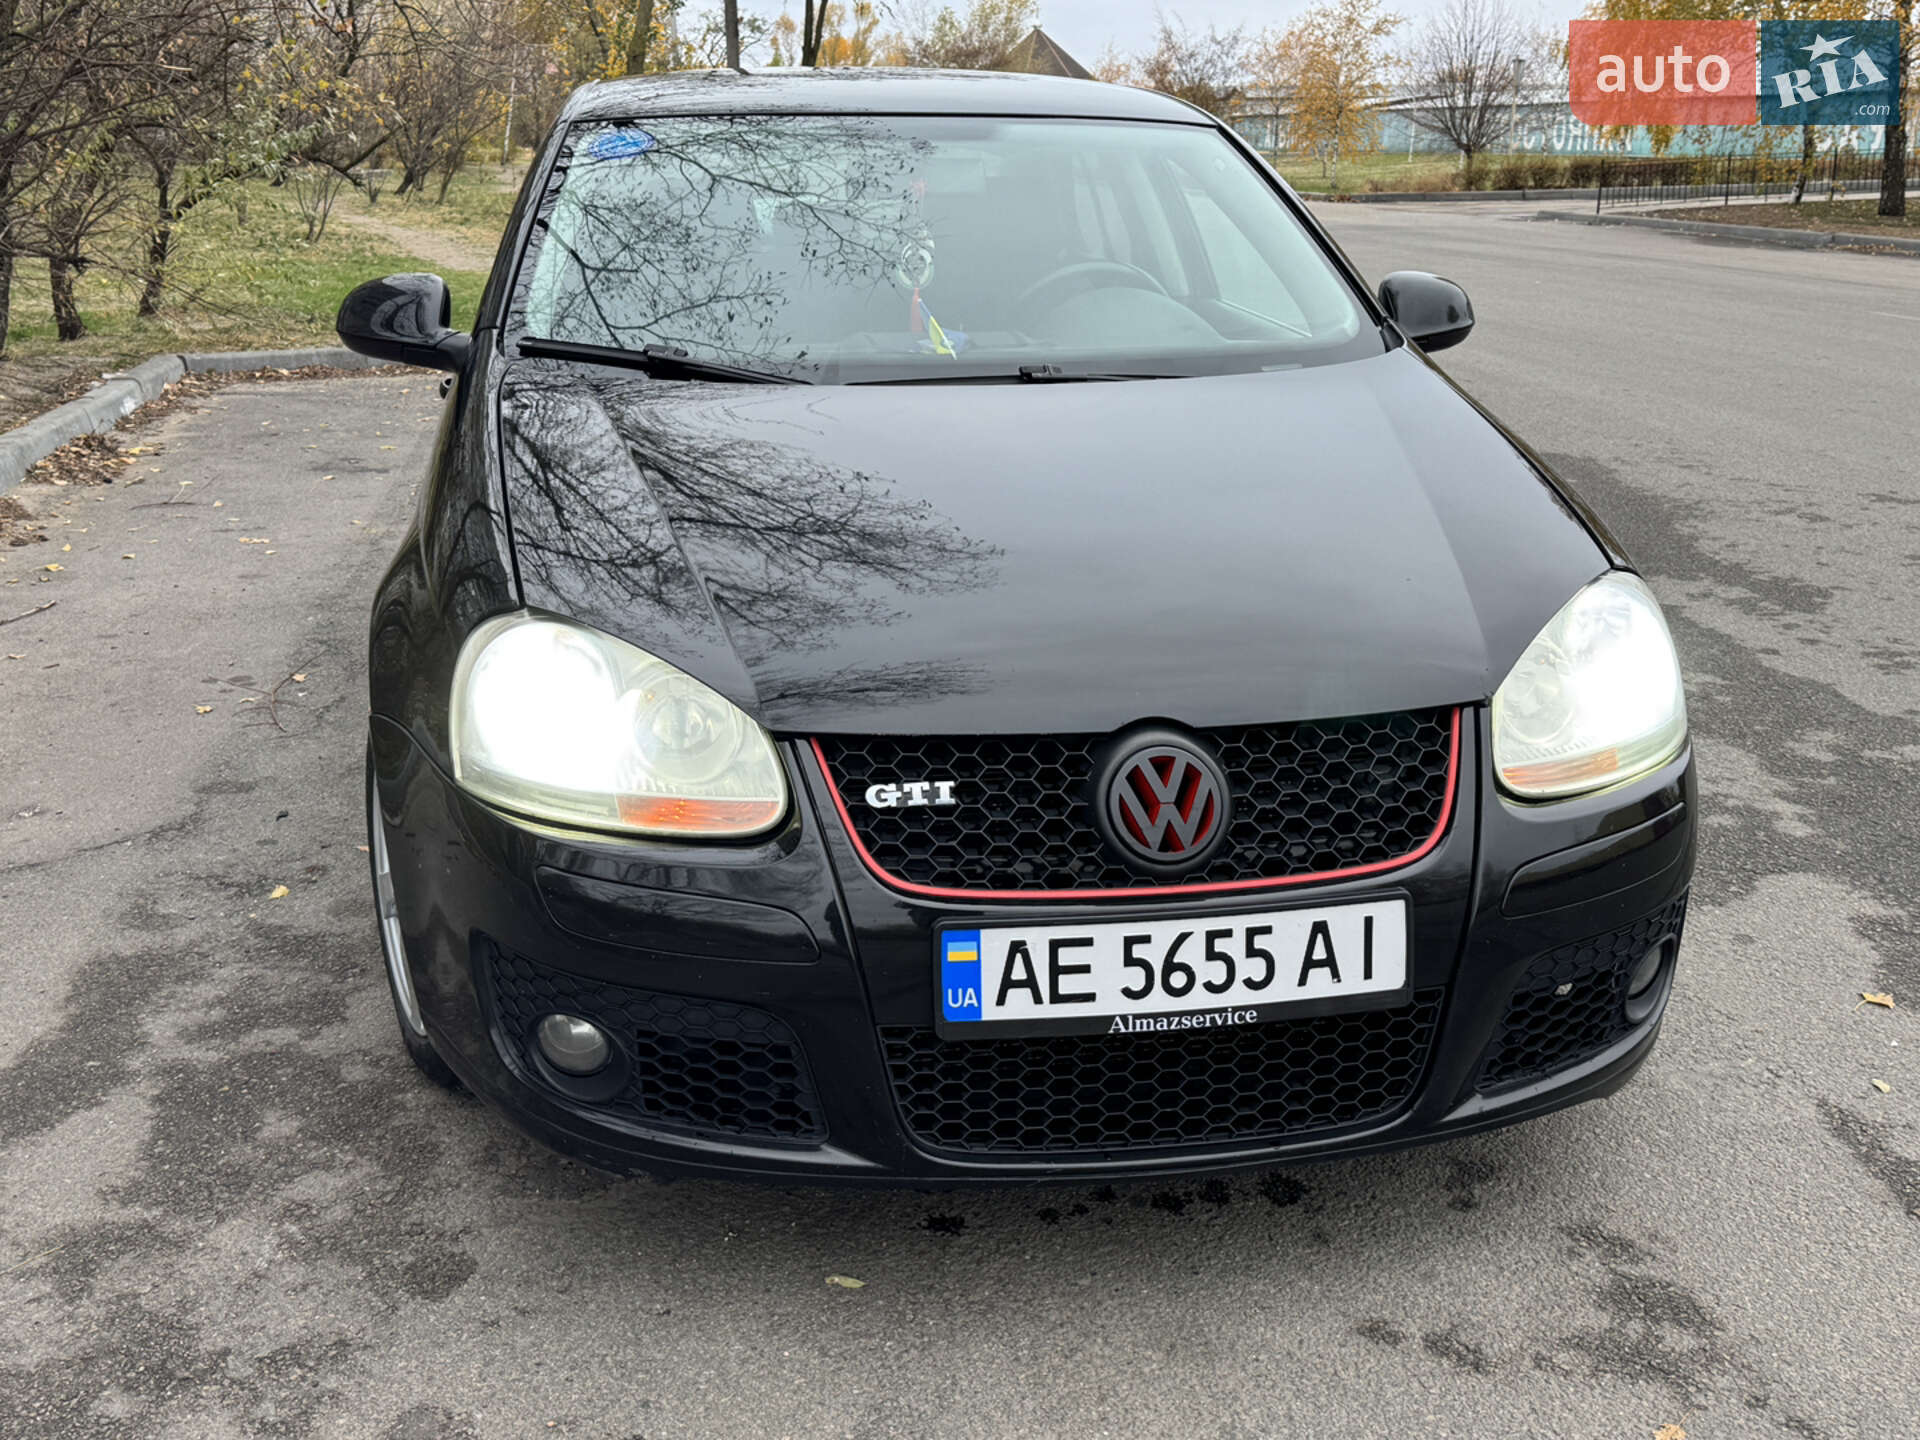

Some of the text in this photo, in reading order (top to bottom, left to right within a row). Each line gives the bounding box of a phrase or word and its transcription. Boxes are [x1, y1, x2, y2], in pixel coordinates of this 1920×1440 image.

[865, 780, 957, 809] GTI
[995, 915, 1374, 1007] AE 5655 AI
[947, 987, 980, 1008] UA
[1108, 1006, 1259, 1034] Almazservice
